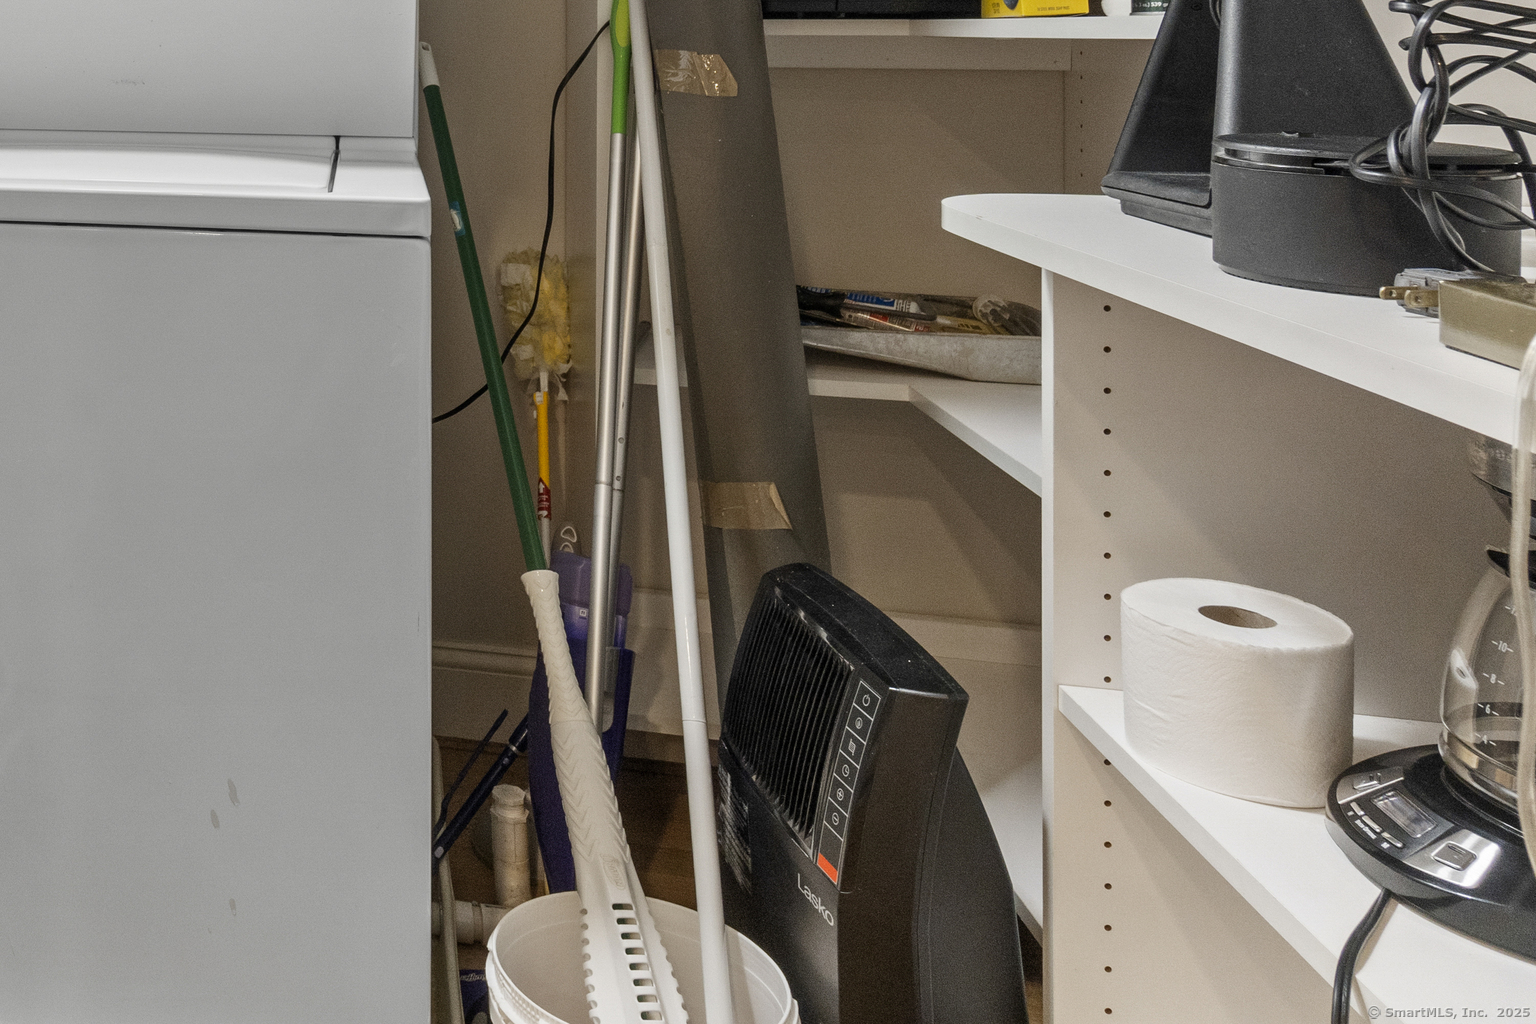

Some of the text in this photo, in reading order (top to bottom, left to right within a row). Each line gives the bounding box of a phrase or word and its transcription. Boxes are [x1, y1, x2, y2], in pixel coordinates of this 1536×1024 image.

[1497, 640, 1508, 652] 10
[1490, 673, 1496, 684] 8
[1485, 704, 1491, 714] 6
[1482, 734, 1488, 744] 4
[797, 872, 835, 926] Lasko
